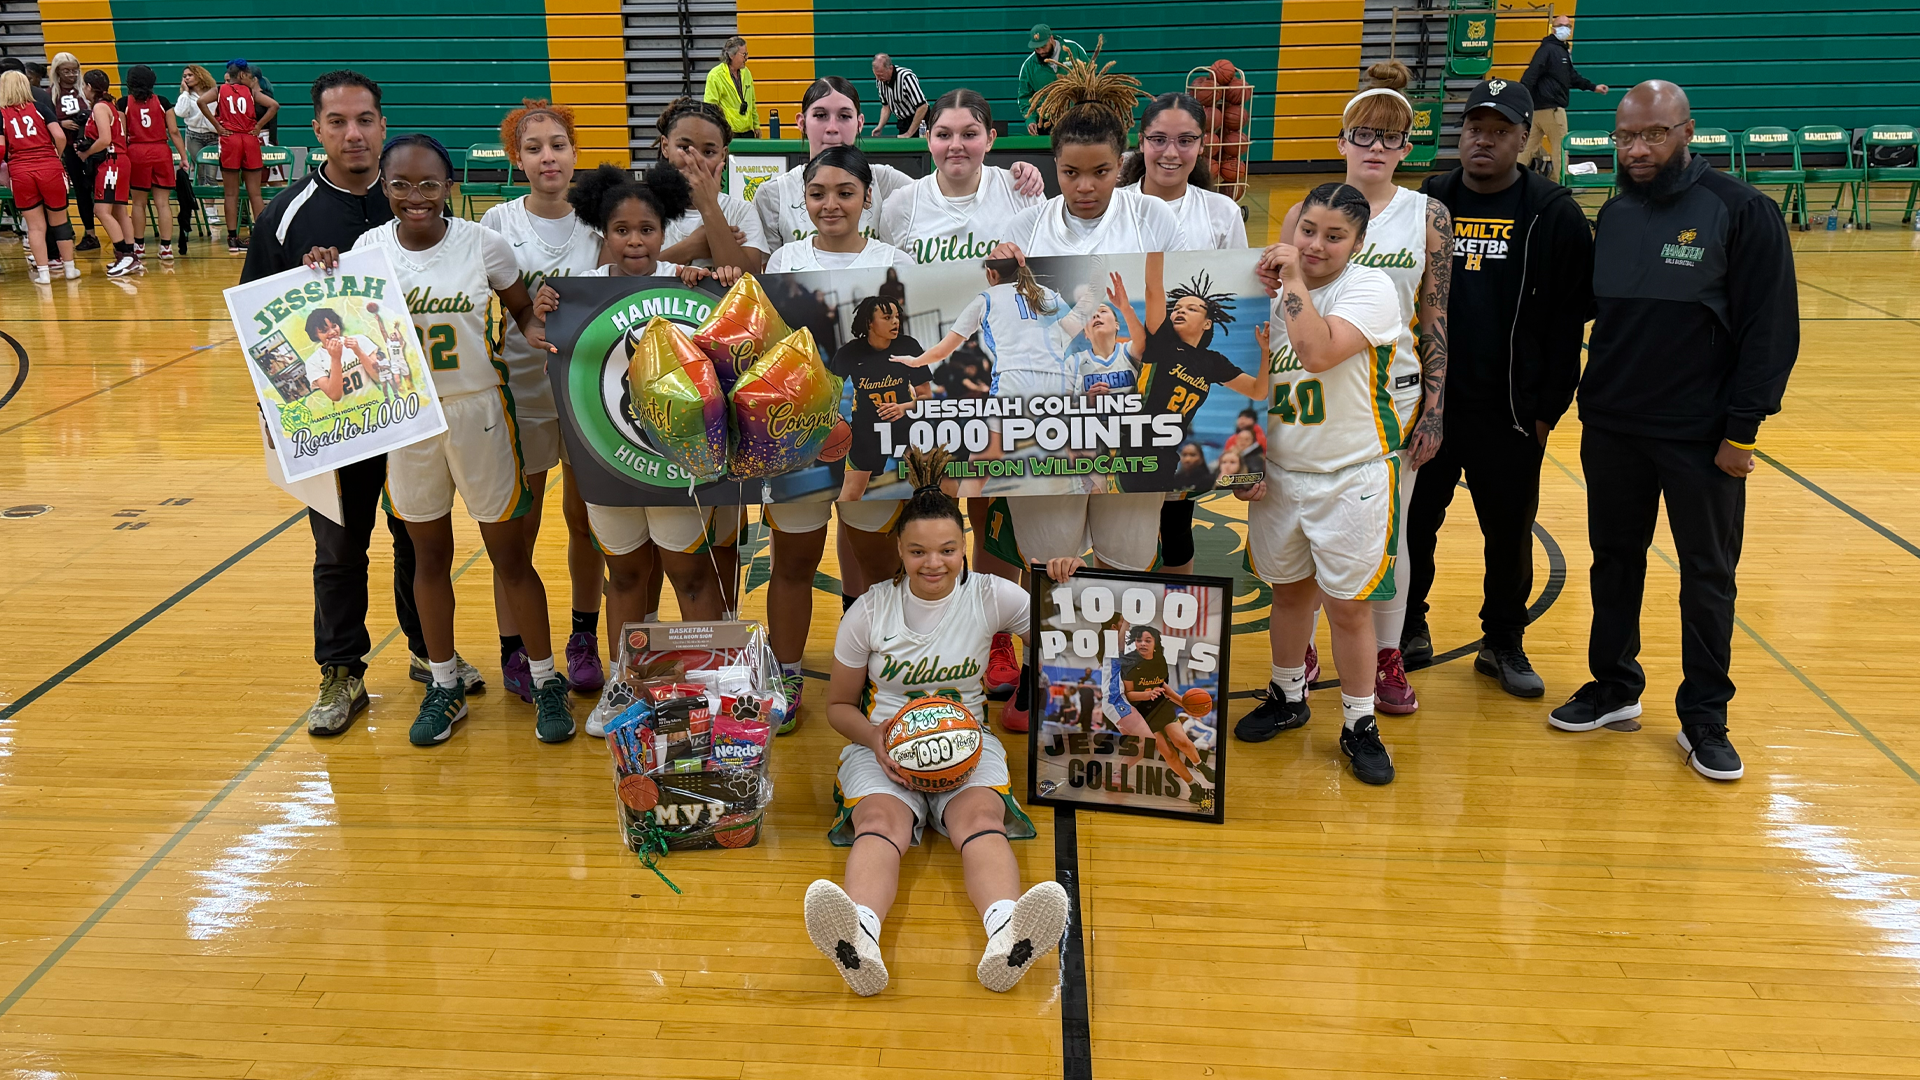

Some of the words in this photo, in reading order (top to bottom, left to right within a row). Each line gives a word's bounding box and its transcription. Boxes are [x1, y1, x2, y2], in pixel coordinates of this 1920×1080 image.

[1461, 40, 1489, 48] WILDCATS
[226, 95, 247, 115] 10
[10, 115, 37, 139] 12
[140, 108, 152, 128] 5
[1570, 137, 1609, 146] HAMILTON
[1692, 135, 1727, 143] AMILTON
[1749, 134, 1789, 143] HAMILTON
[1804, 132, 1843, 141] HAMILTON
[1873, 131, 1913, 140] HAMILTON
[261, 152, 286, 160] MILTON
[735, 165, 780, 174] HAMILTON
[912, 231, 1001, 265] Wildca
[1464, 253, 1483, 271] H
[252, 275, 387, 337] JESSIAH
[610, 297, 712, 332] HAMILTO
[342, 370, 364, 396] 20
[858, 374, 904, 390] Hamilton
[312, 412, 341, 424] HAMILTON
[341, 406, 356, 415] HIGH
[356, 399, 380, 410] SCHOOL
[905, 397, 1022, 419] JESSIAH
[1029, 393, 1143, 416] COLLINS
[1166, 385, 1201, 418] 20
[1268, 377, 1326, 426] 40
[291, 416, 341, 458] Road
[341, 416, 361, 441] to
[361, 392, 420, 434] 1,000
[873, 418, 989, 458] 1,000
[1002, 413, 1184, 451] POINTS
[613, 444, 660, 477] HIGH
[898, 460, 1024, 479] HMILTON
[1052, 586, 1198, 630] 1000
[879, 654, 981, 686] Wildcats
[690, 735, 711, 747] IKE
[911, 735, 953, 768] 1000
[1044, 732, 1210, 768] JESSI
[1068, 758, 1181, 798] COLLINS
[654, 804, 725, 826] MVP
